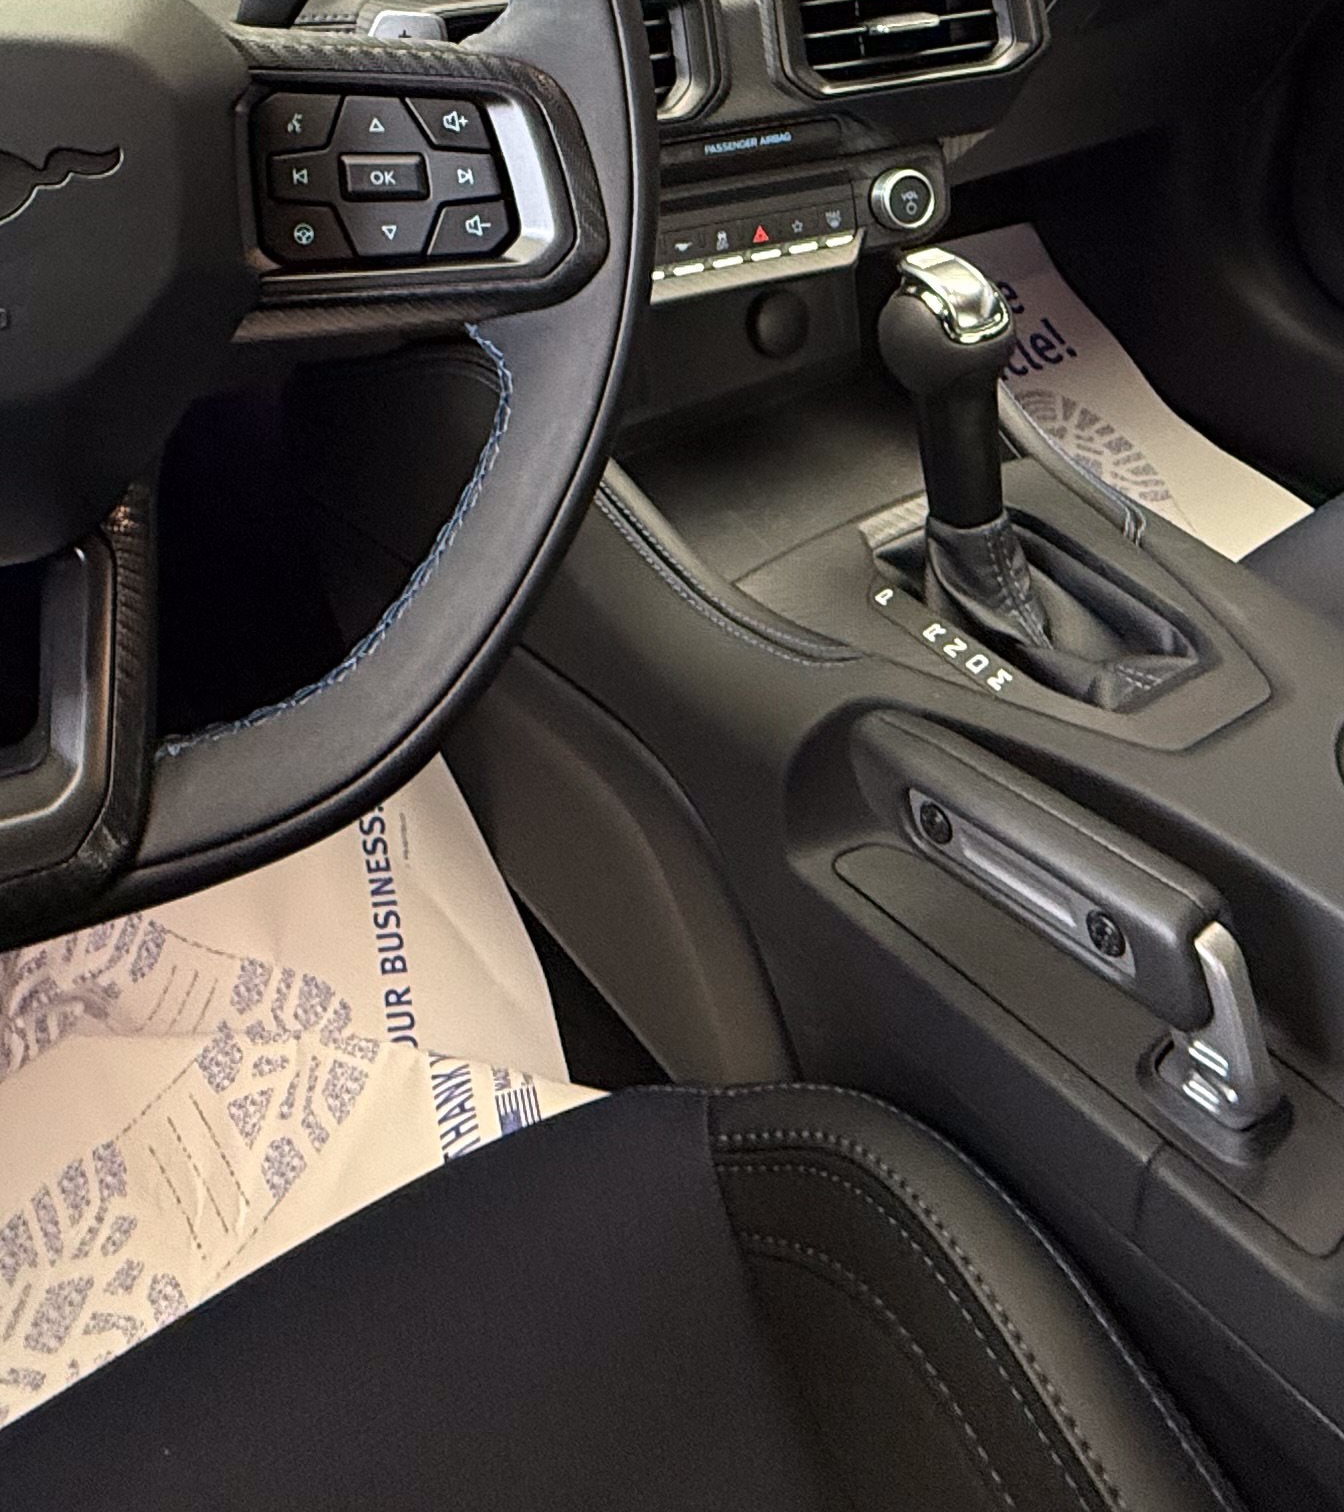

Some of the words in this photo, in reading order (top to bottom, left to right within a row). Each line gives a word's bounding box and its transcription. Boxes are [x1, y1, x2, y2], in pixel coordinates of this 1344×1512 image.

[704, 137, 758, 155] PASSENGER
[759, 131, 792, 146] AIRBAG
[370, 170, 396, 185] OK
[901, 190, 918, 202] VOL
[874, 588, 894, 606] P
[922, 623, 947, 643] R
[943, 637, 968, 659] N
[965, 653, 990, 675] D
